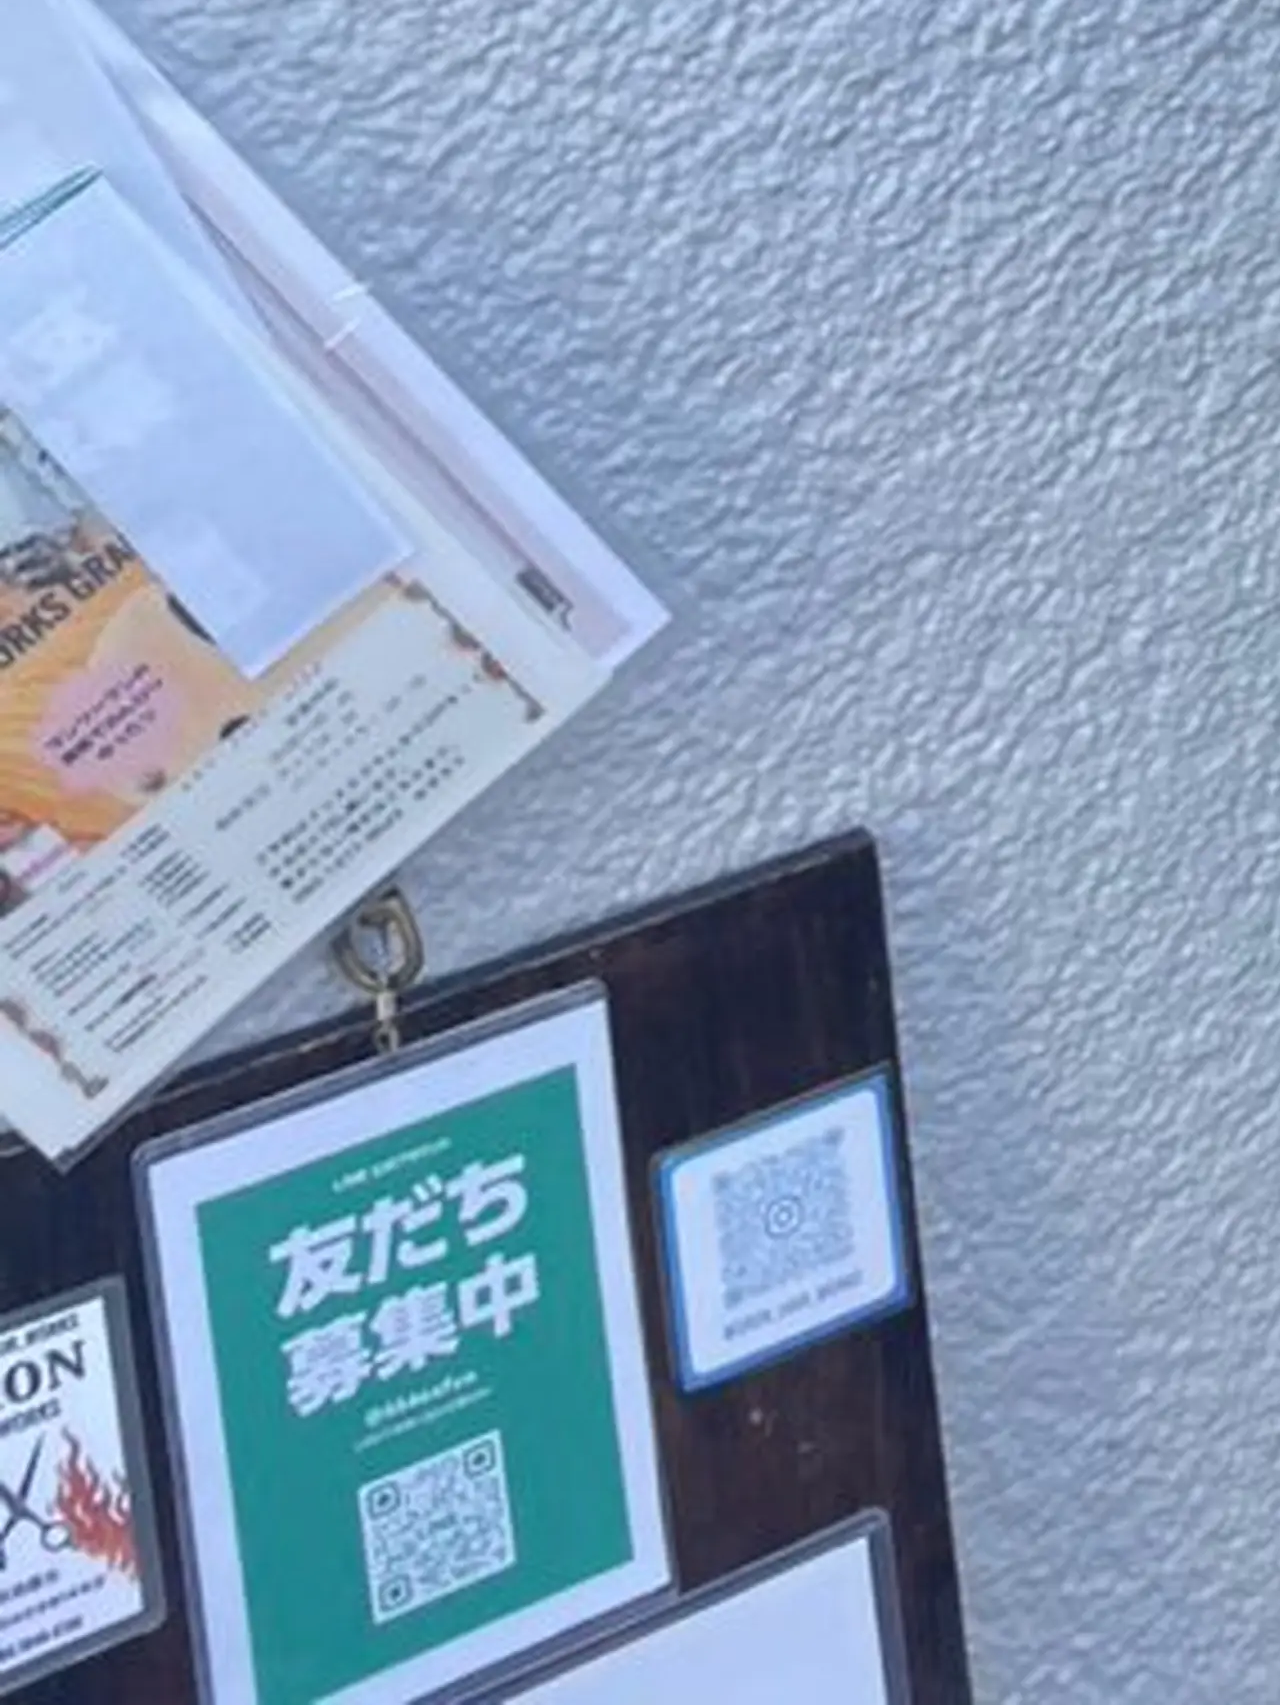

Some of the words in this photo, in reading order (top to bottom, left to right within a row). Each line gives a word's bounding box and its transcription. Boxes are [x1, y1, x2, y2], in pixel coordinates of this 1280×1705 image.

[269, 1153, 528, 1318] 友だち
[0, 1338, 88, 1410] ON
[281, 1253, 540, 1417] 募集中
